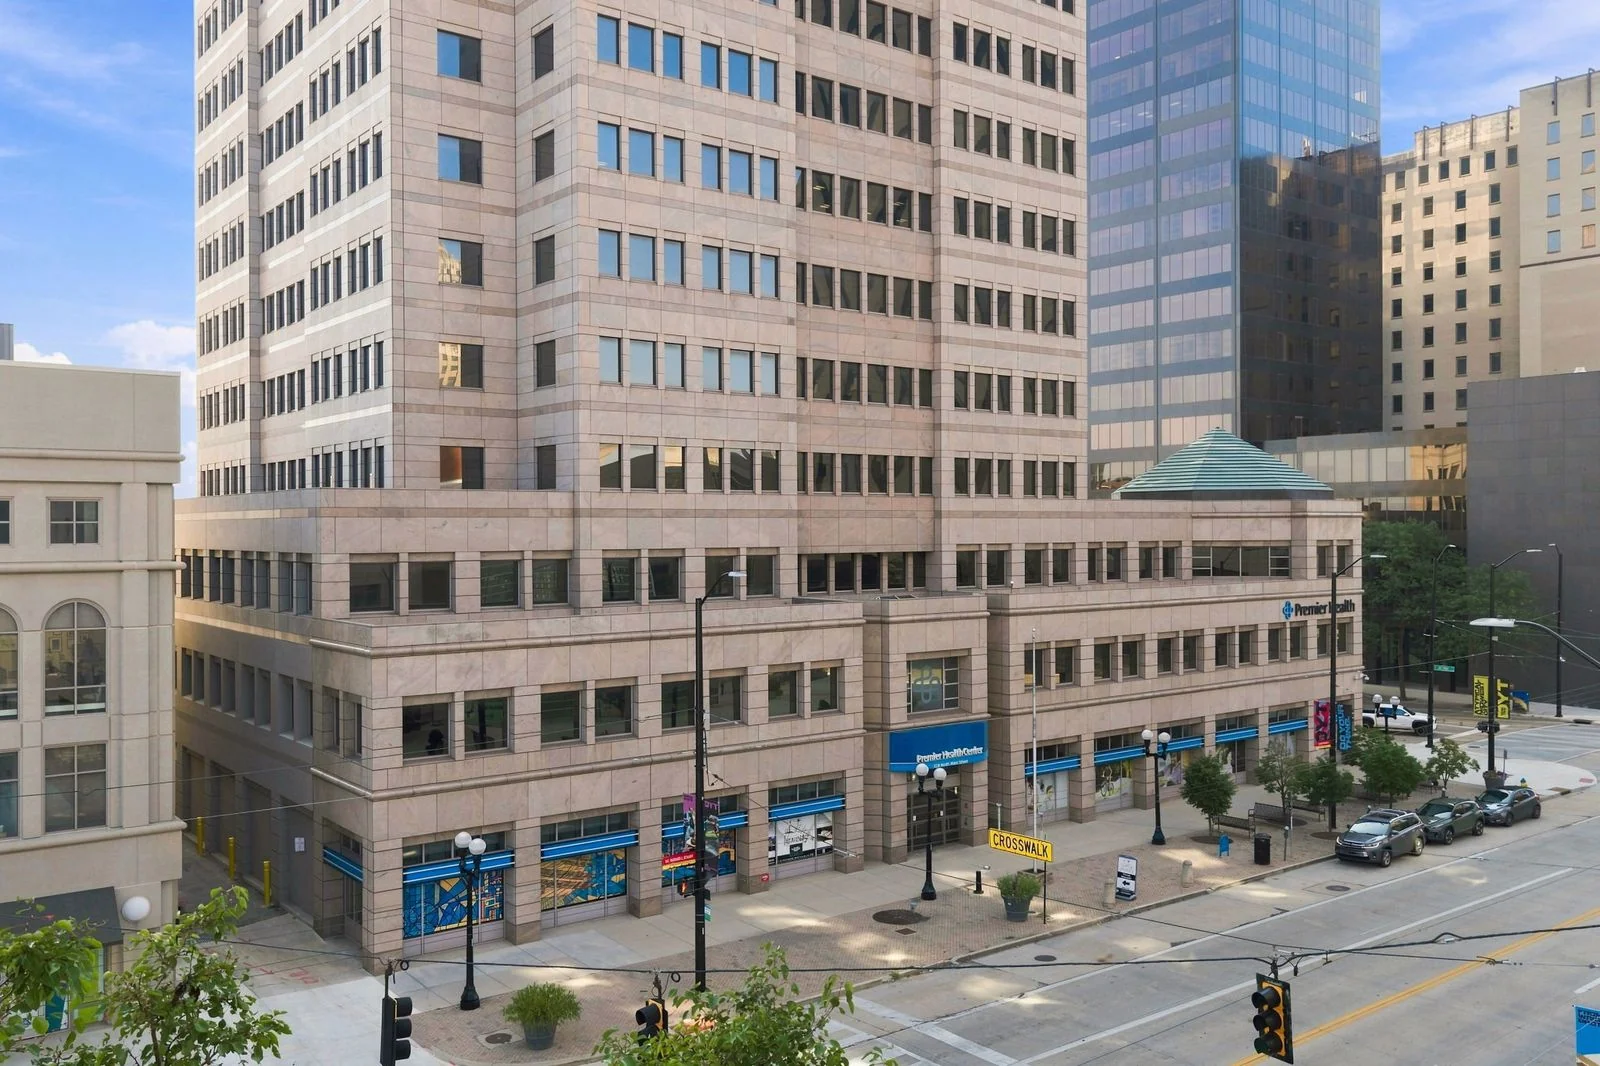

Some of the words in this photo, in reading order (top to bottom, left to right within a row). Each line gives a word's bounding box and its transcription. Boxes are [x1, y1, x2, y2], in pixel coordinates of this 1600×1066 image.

[1294, 601, 1328, 616] Premier
[916, 752, 942, 763] Premier
[993, 832, 1049, 858] CROSSWALK
